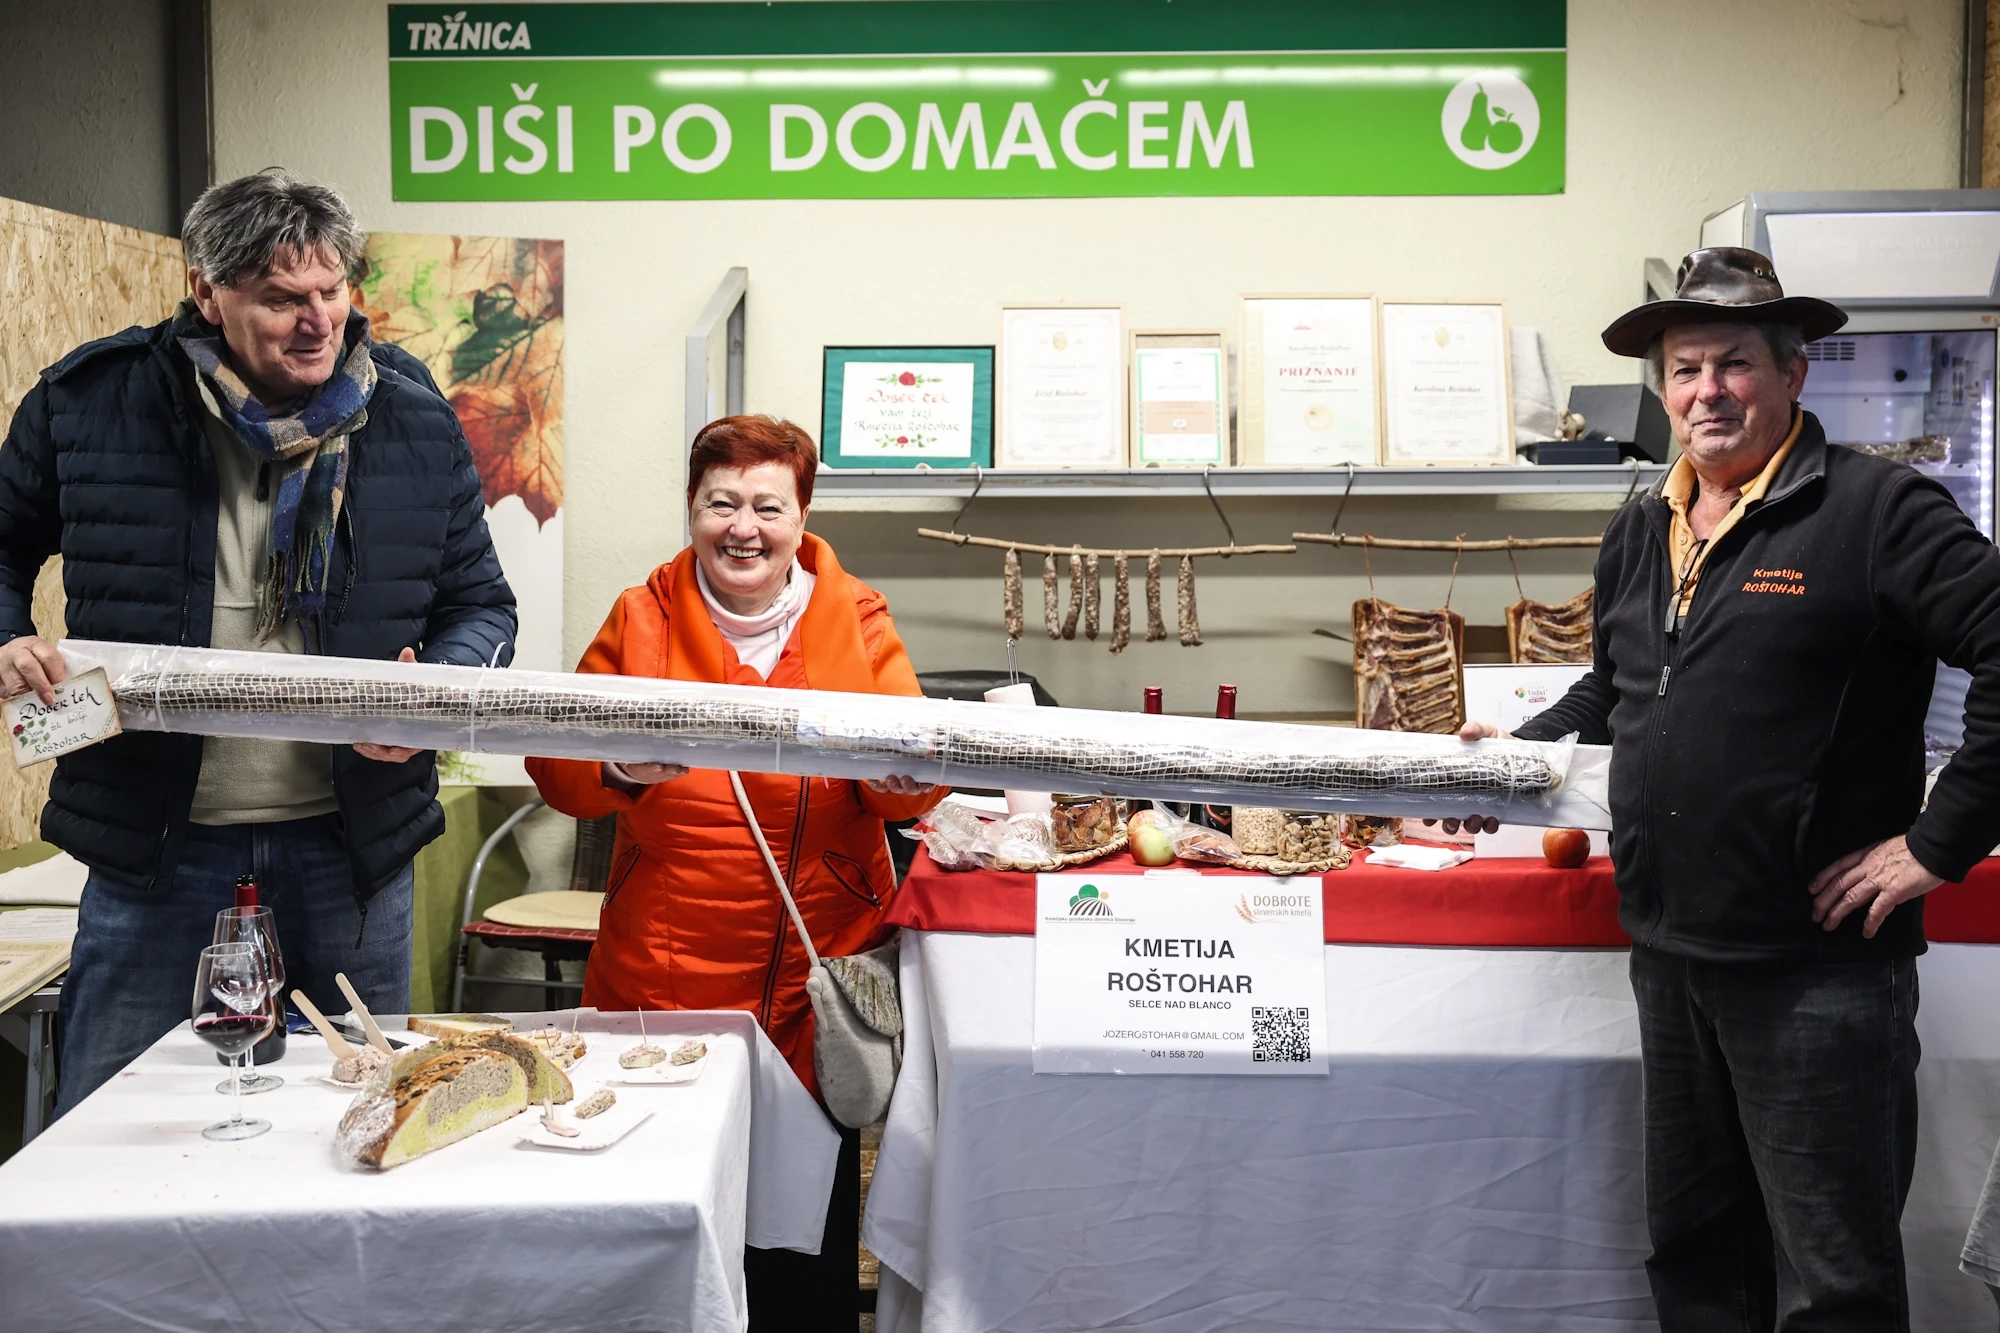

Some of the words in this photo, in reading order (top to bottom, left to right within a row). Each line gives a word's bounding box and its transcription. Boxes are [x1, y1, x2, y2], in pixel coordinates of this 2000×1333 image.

[407, 12, 531, 50] TRŽNICA
[409, 83, 574, 174] DIŠI
[613, 103, 732, 173] PO
[770, 79, 1255, 172] DOMAČEM
[1279, 367, 1358, 376] PRIZNANJE
[1753, 569, 1803, 580] Kmetija
[1742, 581, 1805, 594] ROŠTOHAR
[1253, 895, 1312, 907] DOBROTE
[1253, 908, 1290, 916] slovenskih
[1291, 908, 1312, 917] kmetij
[1125, 938, 1235, 958] KMETIJA
[1108, 968, 1252, 994] ROŠTOHAR
[1128, 999, 1163, 1009] SELCE
[1165, 1000, 1186, 1009] NAD
[1189, 1001, 1232, 1010] BLANCO
[1103, 1029, 1245, 1041] JOZEROSTOHAR@GMAIL.COM
[1151, 1050, 1166, 1058] 041
